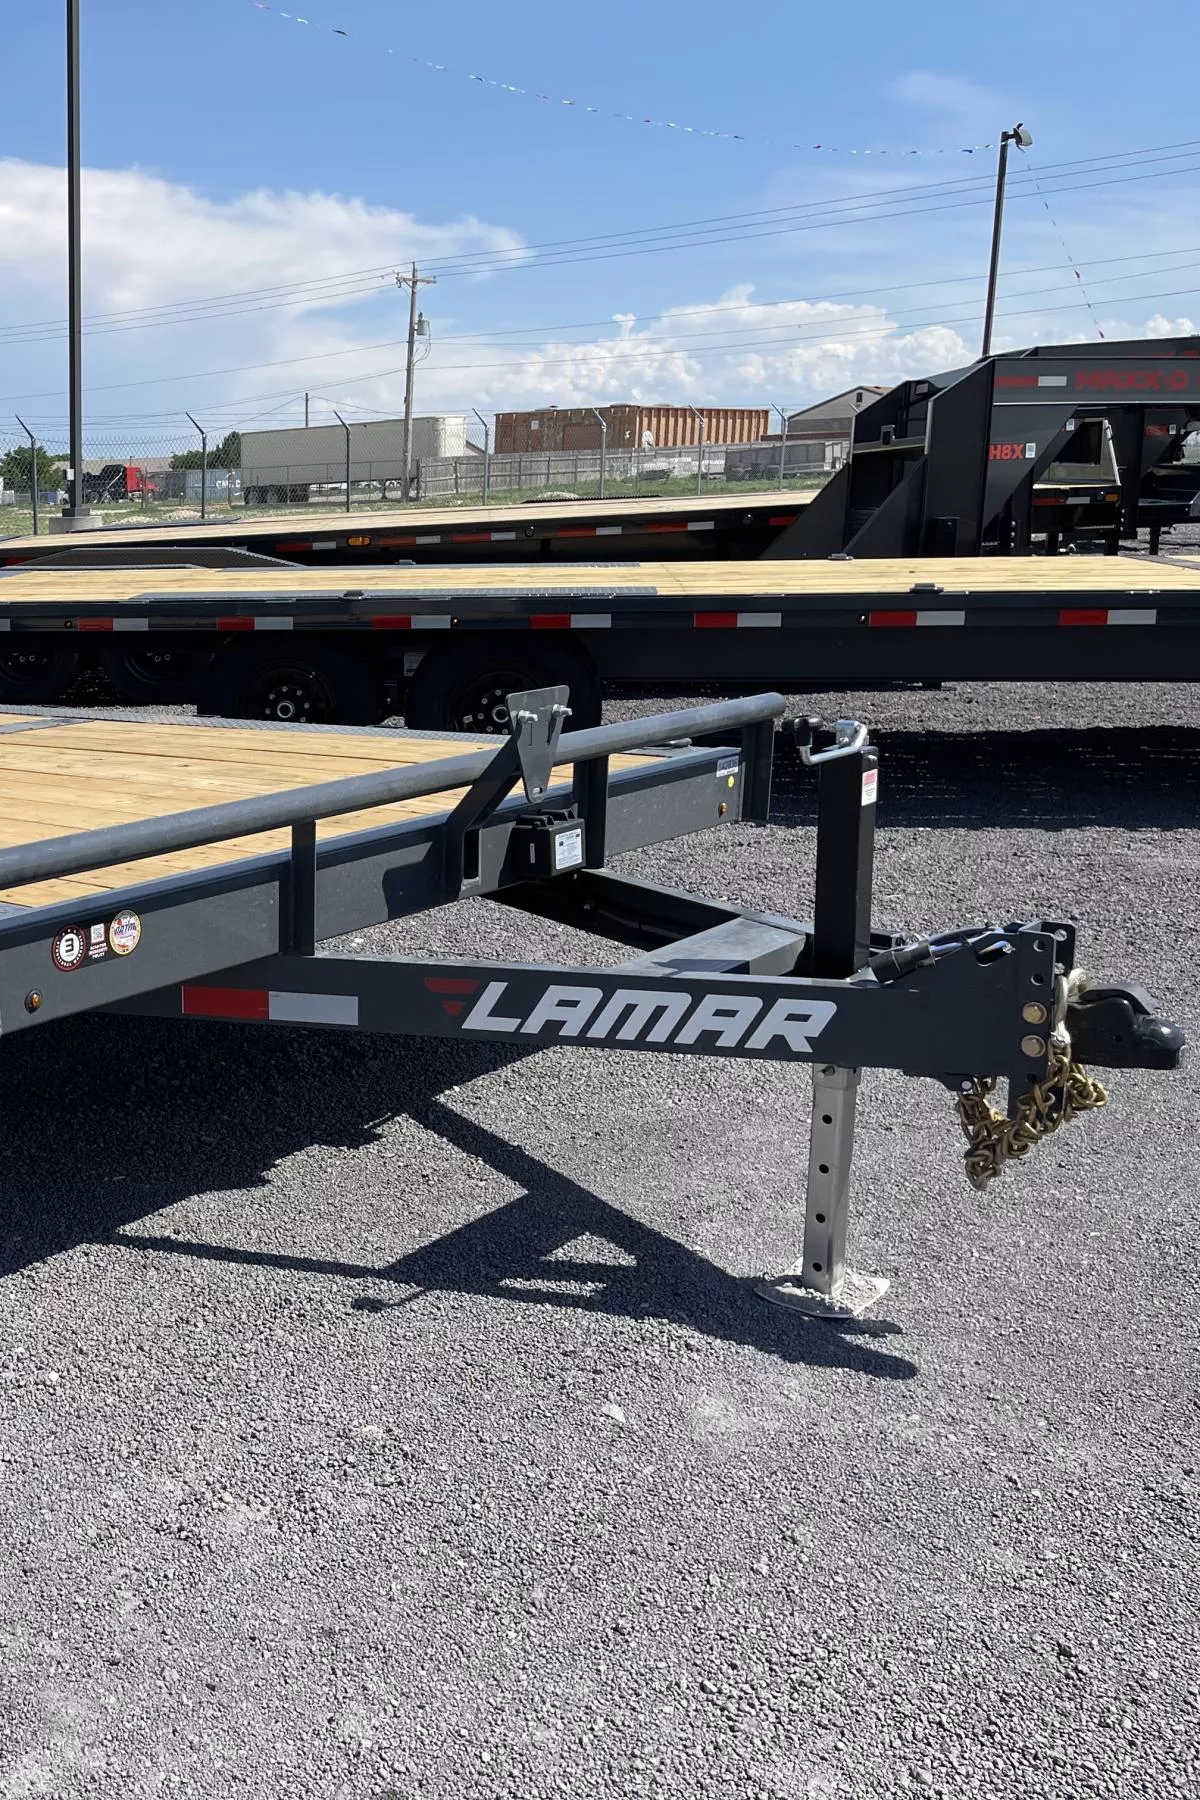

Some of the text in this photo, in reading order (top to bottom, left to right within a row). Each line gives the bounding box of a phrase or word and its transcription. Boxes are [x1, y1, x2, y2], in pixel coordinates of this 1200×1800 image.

[989, 443, 1025, 459] H8X
[65, 937, 74, 954] 3
[461, 981, 838, 1053] LAMAR
